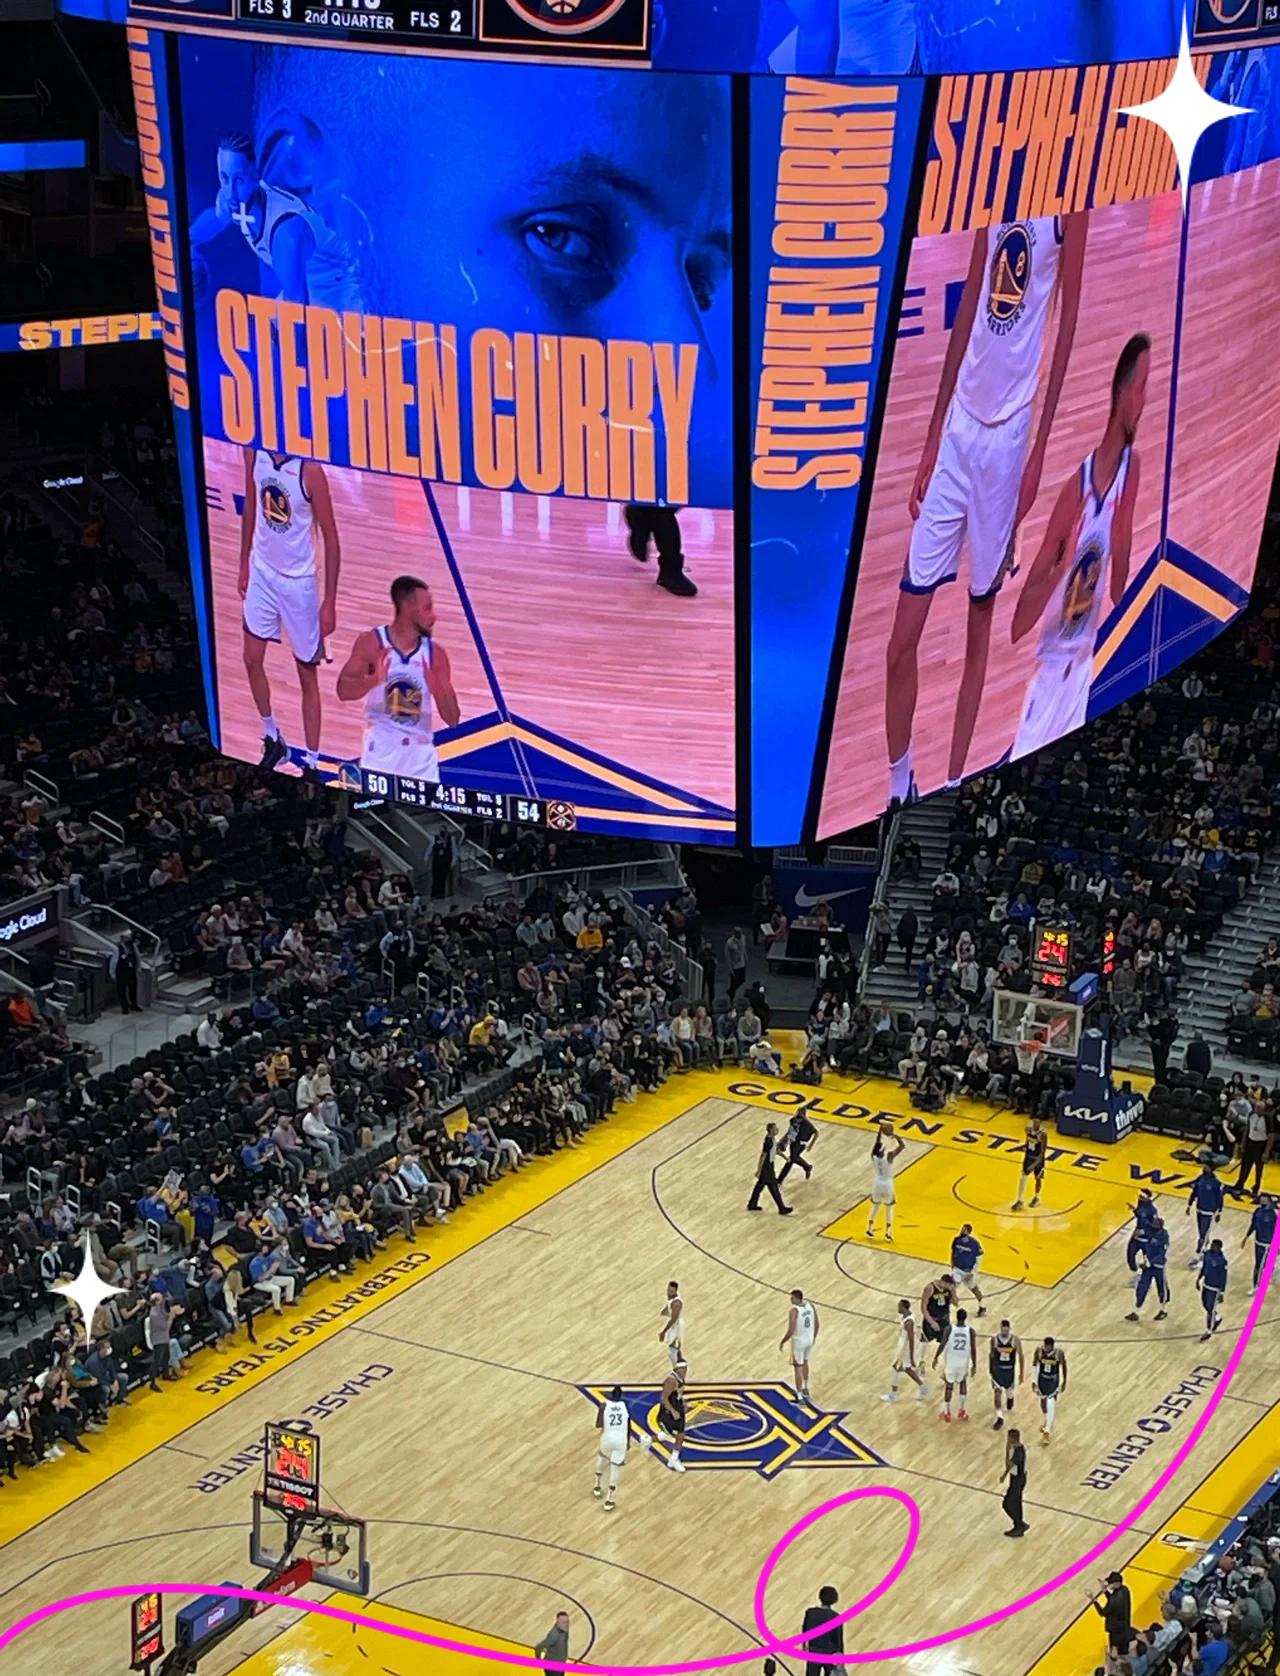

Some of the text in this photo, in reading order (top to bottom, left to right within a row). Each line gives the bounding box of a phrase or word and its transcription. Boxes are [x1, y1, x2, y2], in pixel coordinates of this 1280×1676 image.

[249, 0, 291, 18] FLS 3
[305, 10, 394, 30] 2nd QUARTER
[410, 10, 462, 32] FLS 2
[917, 65, 1110, 237] STEPHEN
[752, 76, 899, 490] STEPHEN CURRY
[18, 311, 162, 351] STEPH
[215, 287, 699, 505] STEPHEN CURRY
[368, 773, 388, 795] 50
[436, 784, 466, 805] 4:15
[496, 808, 502, 818] 2
[517, 801, 540, 822] 54
[20, 907, 47, 930] Cloud
[1038, 940, 1066, 965] 24
[728, 1082, 945, 1137] GOLDEN
[289, 1251, 432, 1337] CELEBRATING
[269, 1339, 299, 1354] 75
[953, 1339, 967, 1351] 22
[195, 1352, 275, 1396] YEARS
[301, 1363, 395, 1420] CHASE
[608, 1413, 623, 1427] 23
[1079, 1364, 1222, 1491] CHASE CENTER
